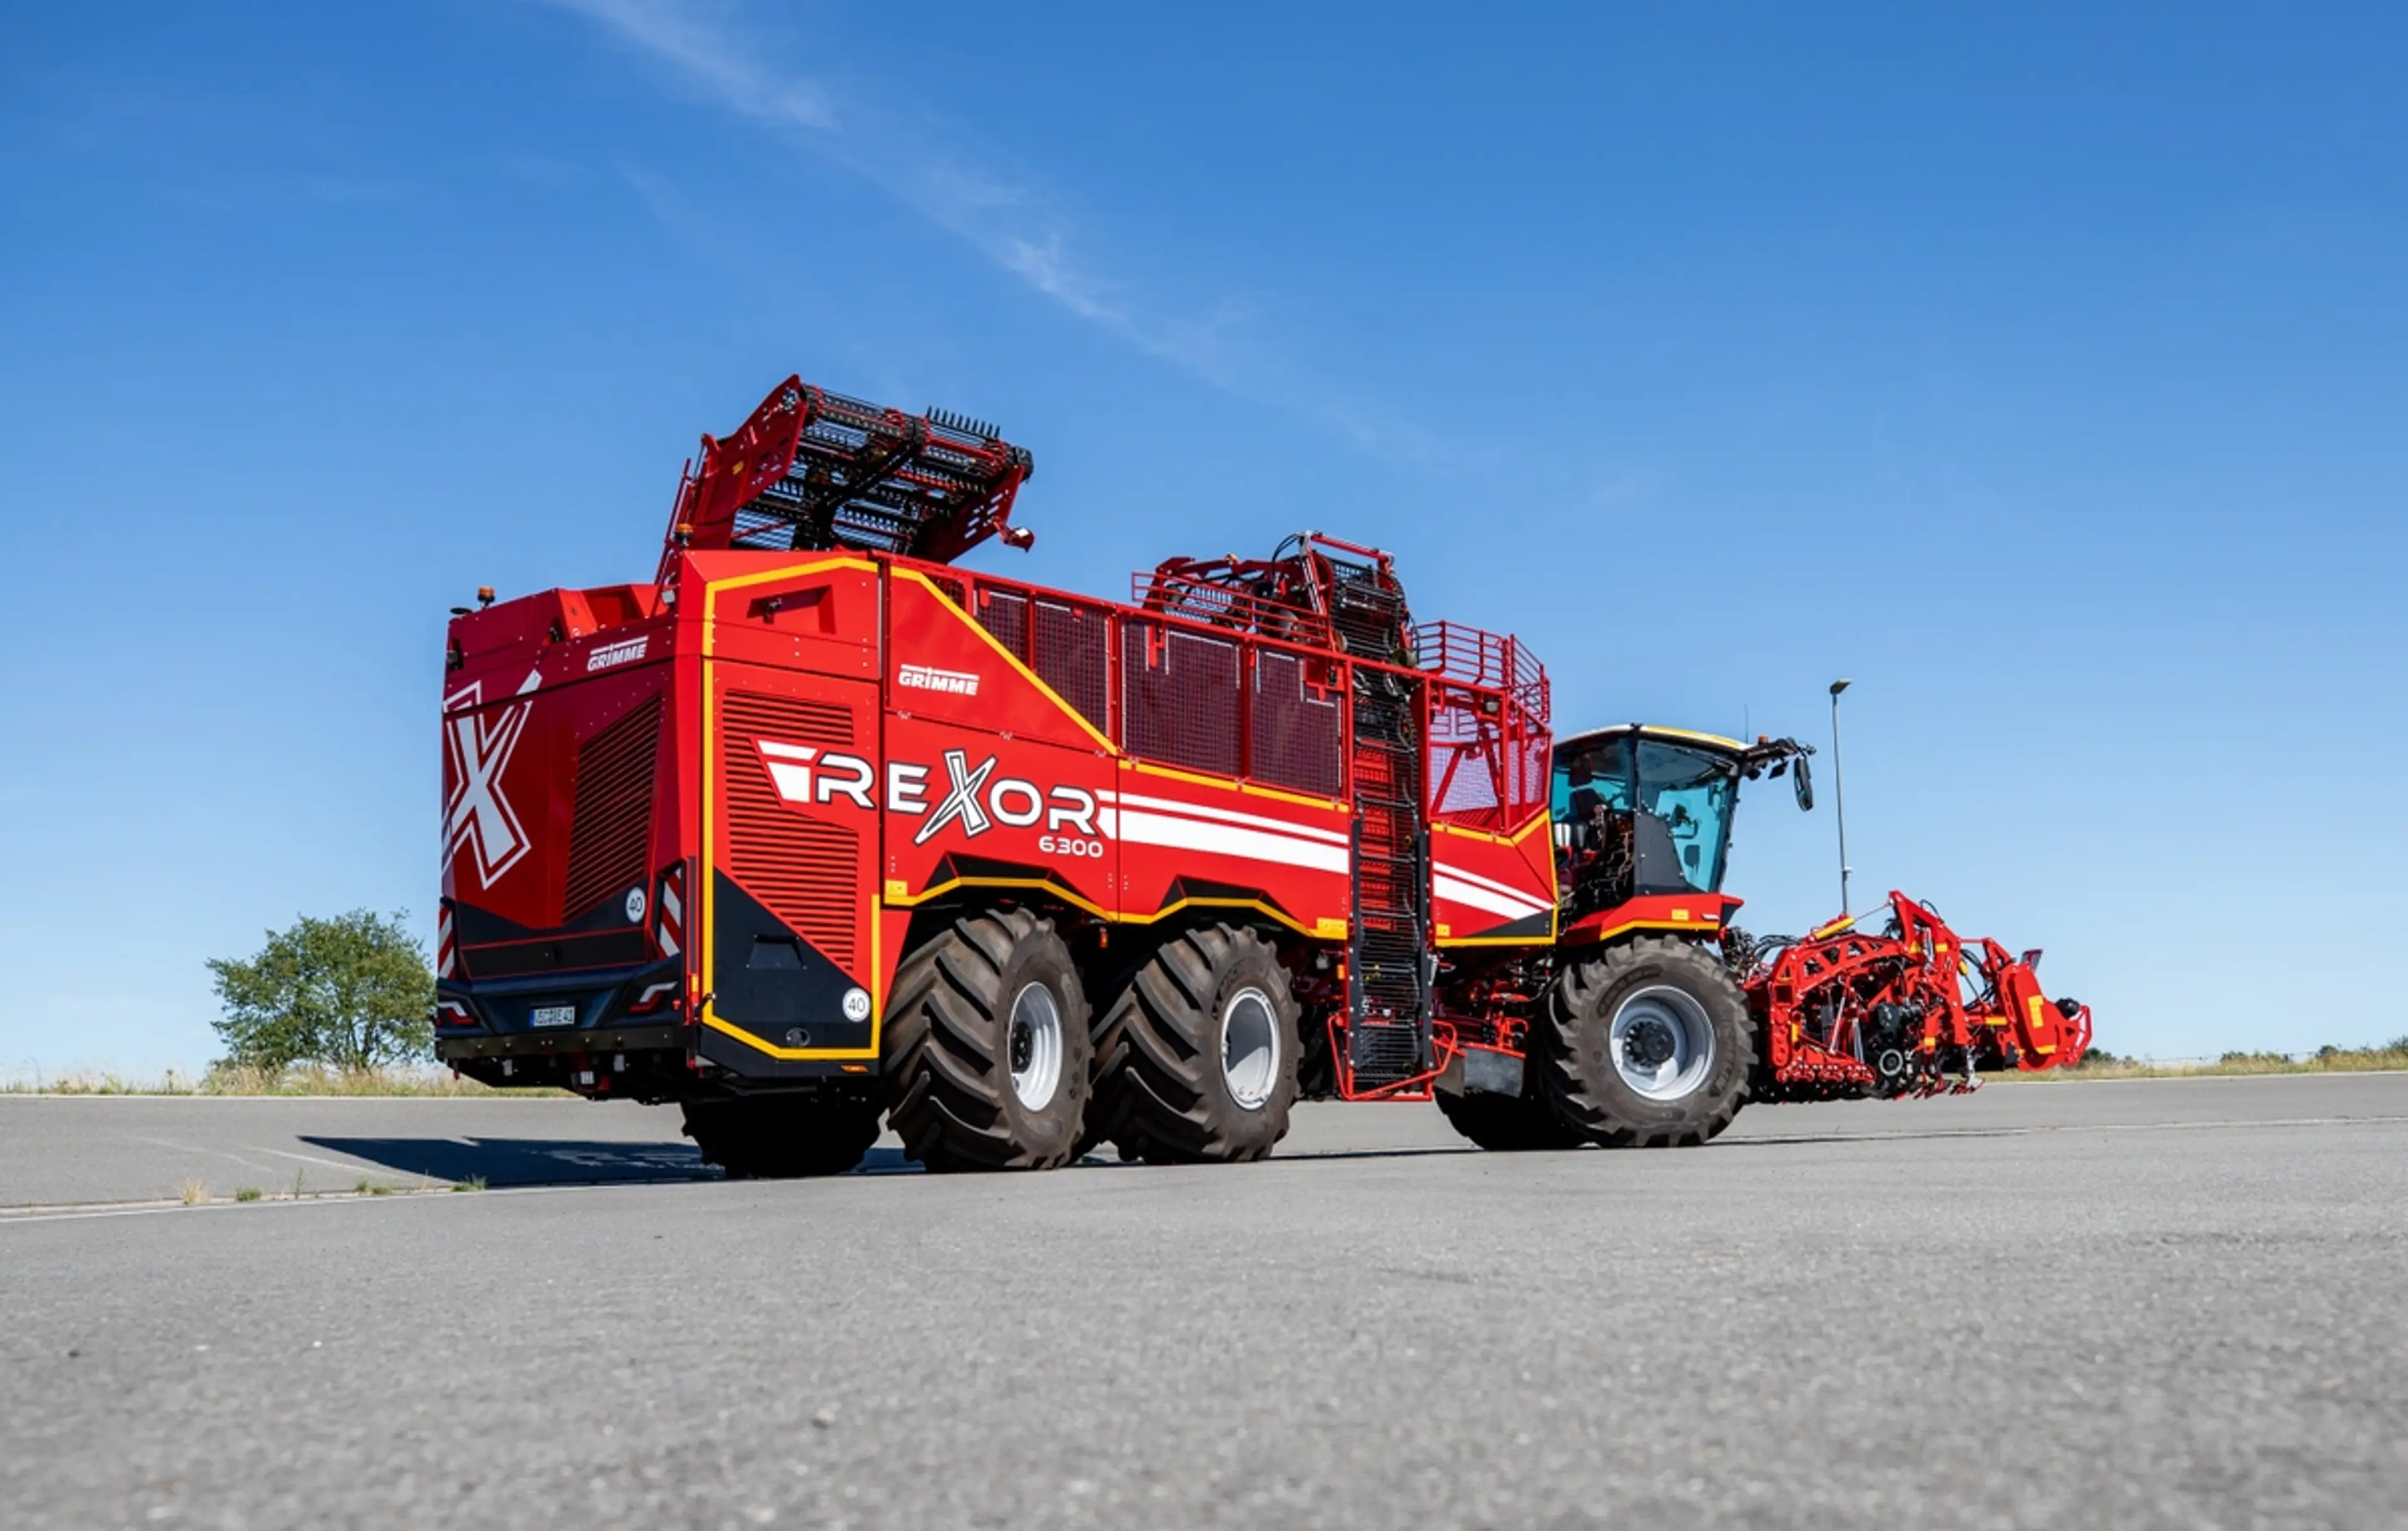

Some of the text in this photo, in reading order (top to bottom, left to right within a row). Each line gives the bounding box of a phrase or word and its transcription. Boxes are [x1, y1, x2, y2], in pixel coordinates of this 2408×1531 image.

[587, 636, 648, 671] GRIMME
[899, 665, 979, 696] GRIMME
[815, 749, 1097, 848] REXOR
[1038, 836, 1104, 858] 6300
[629, 897, 643, 913] 40
[848, 997, 865, 1013] 40
